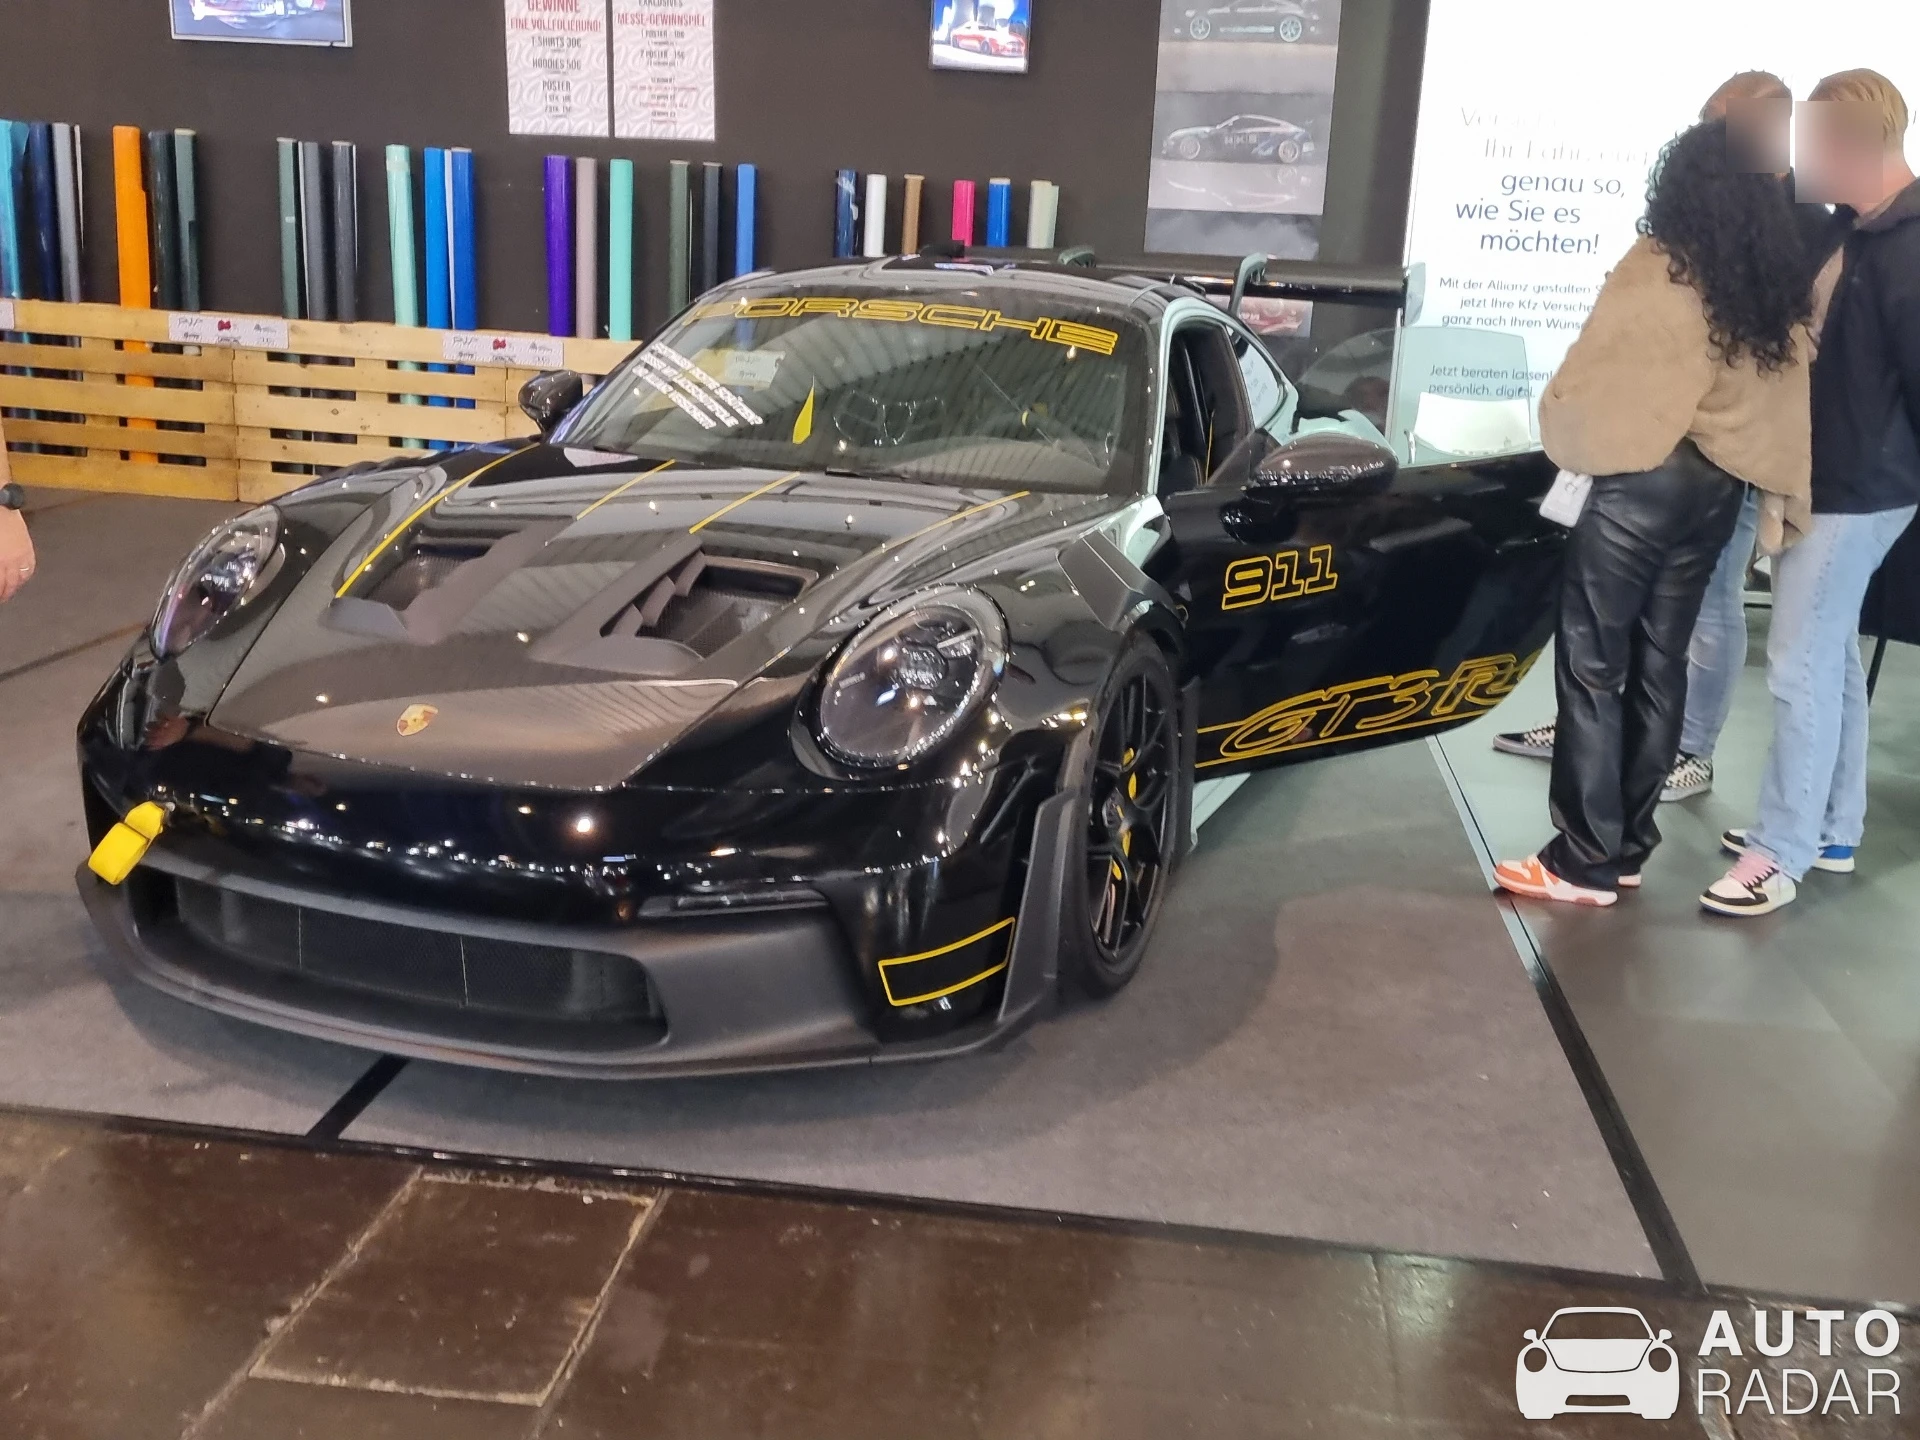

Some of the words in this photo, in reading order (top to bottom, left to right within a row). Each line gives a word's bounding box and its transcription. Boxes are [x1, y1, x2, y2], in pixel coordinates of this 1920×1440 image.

[542, 80, 571, 92] POSTER
[1501, 174, 1584, 196] genau
[1593, 178, 1626, 198] so,
[1455, 197, 1499, 220] wie
[1508, 199, 1545, 223] Sie
[1554, 206, 1581, 224] es
[1480, 229, 1600, 254] möchten!
[1439, 276, 1459, 289] Mit
[1463, 278, 1483, 290] der
[1487, 280, 1529, 292] Allianz
[1532, 283, 1591, 295] gestalten
[1460, 296, 1487, 309] jetzt
[1491, 297, 1515, 309] Ihre
[1543, 300, 1595, 313] Versiche
[682, 297, 1119, 355] PORSCHE
[1441, 314, 1473, 327] ganz
[1476, 315, 1506, 327] nach
[1510, 316, 1542, 328] Ihren
[1429, 364, 1458, 377] Jetzt
[1461, 365, 1508, 379] beraten
[1221, 544, 1338, 610] 911
[1220, 669, 1440, 758] GT3
